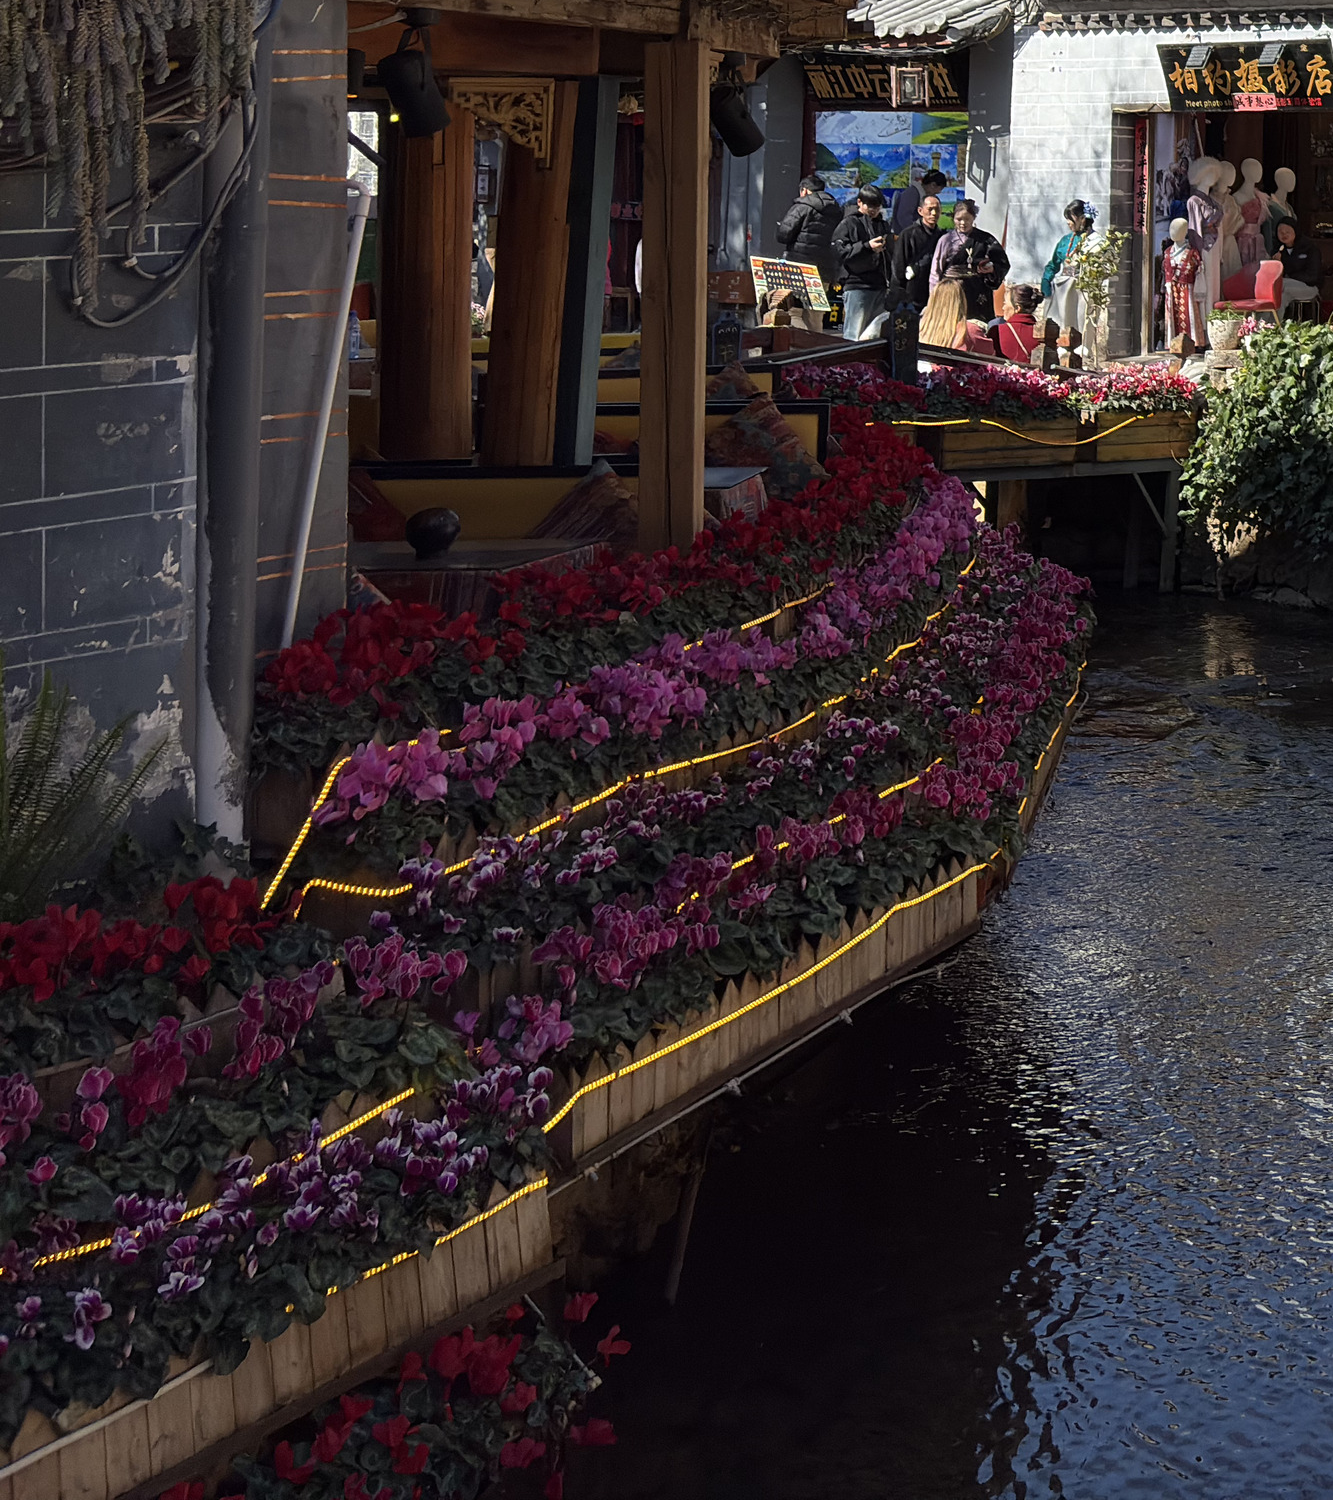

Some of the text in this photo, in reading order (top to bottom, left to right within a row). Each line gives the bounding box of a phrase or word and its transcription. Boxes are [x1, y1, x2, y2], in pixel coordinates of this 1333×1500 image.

[803, 63, 959, 99] 丽江中云社
[1168, 53, 1333, 97] 相约摄影店
[1185, 99, 1203, 108] Meet
[1204, 99, 1223, 109] photo
